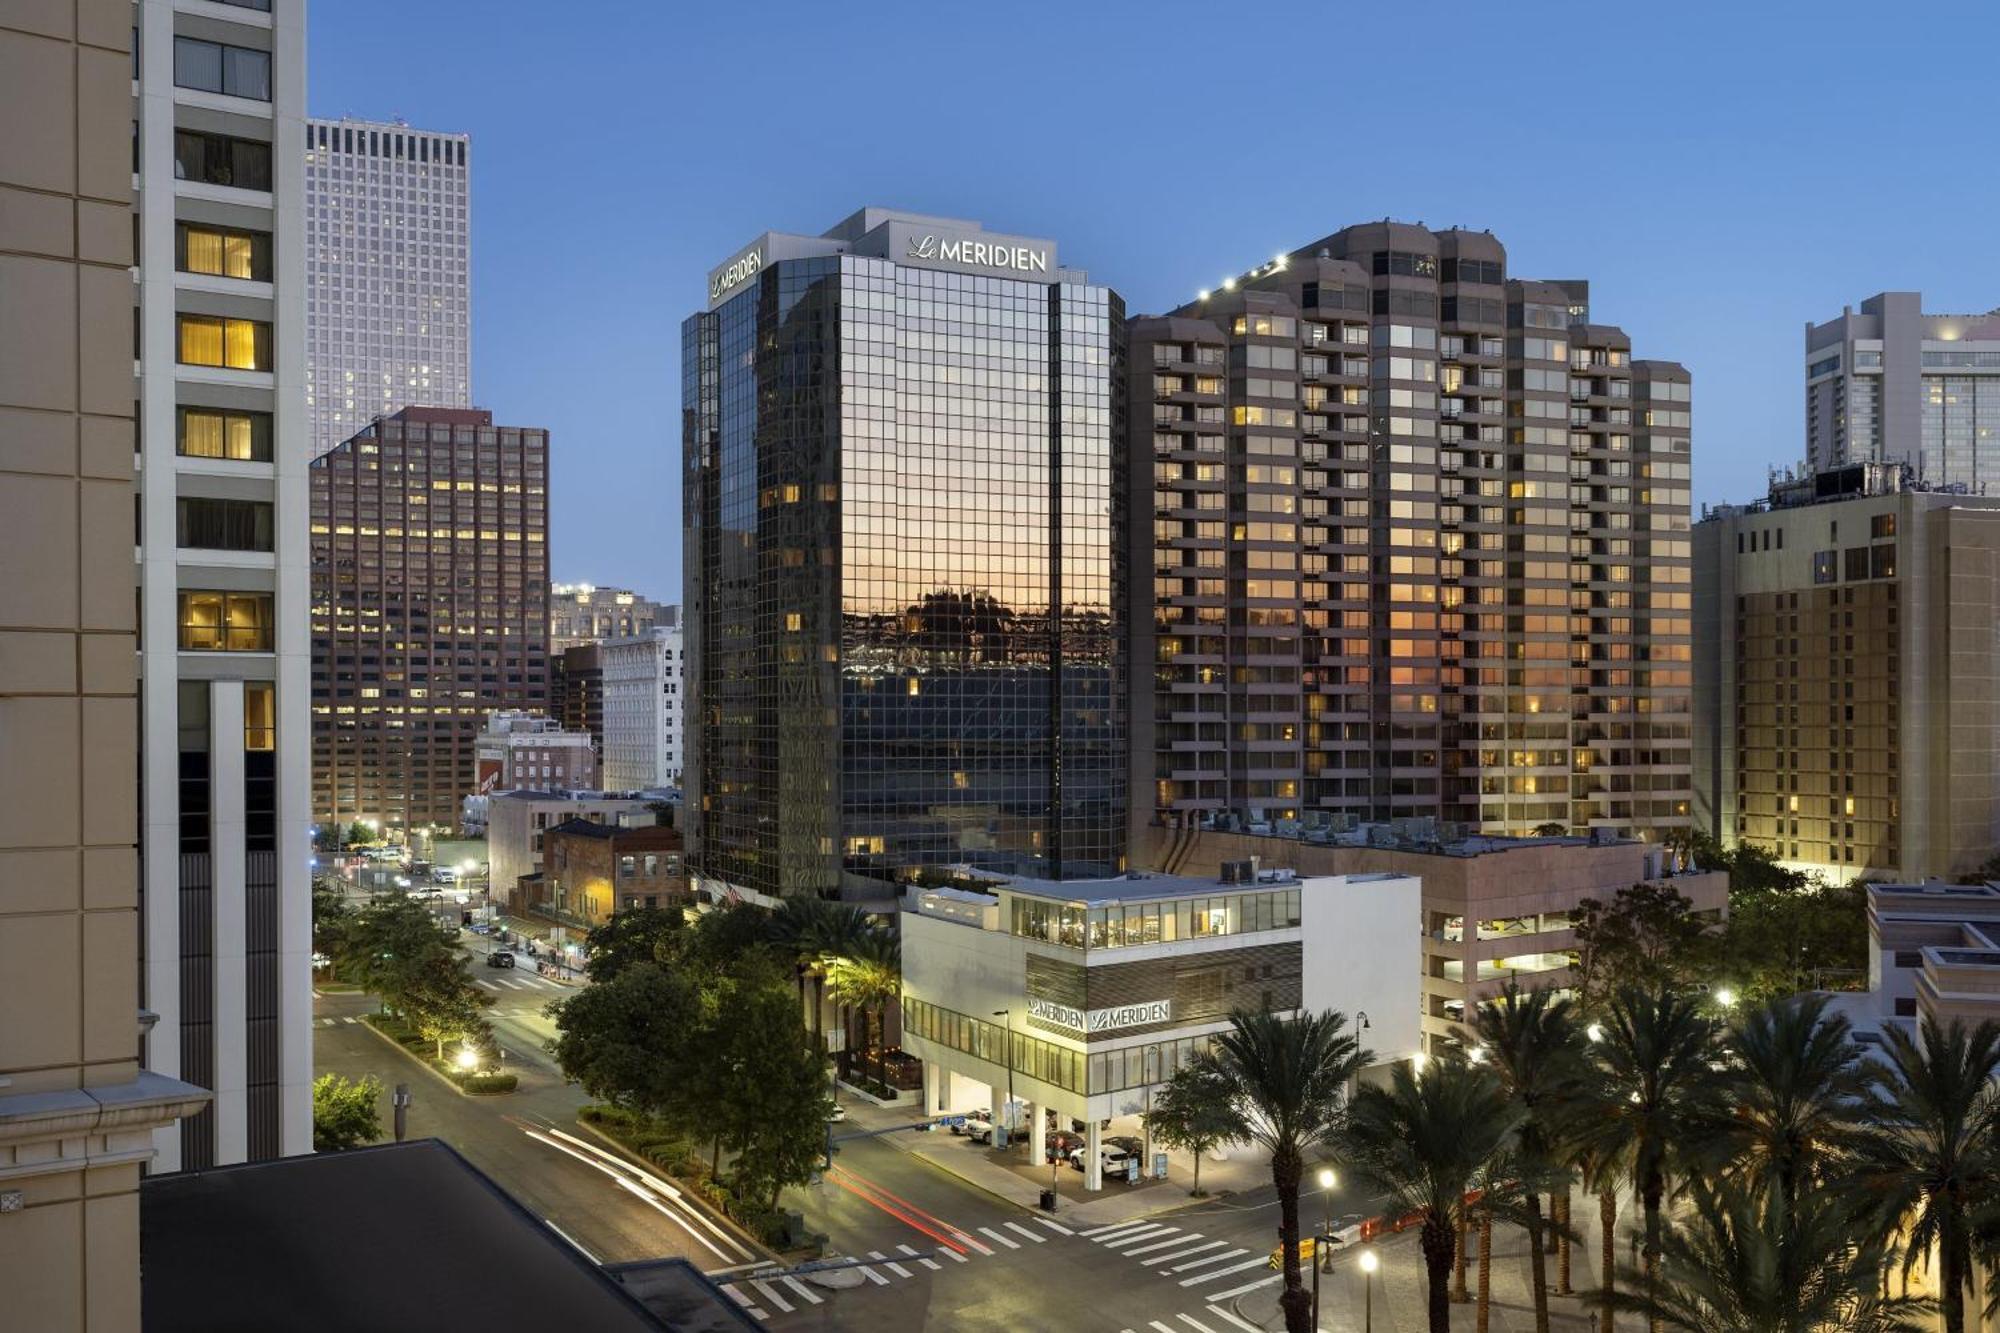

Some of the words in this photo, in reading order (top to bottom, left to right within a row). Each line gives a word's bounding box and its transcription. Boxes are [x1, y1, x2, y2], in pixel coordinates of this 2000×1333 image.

[908, 235, 937, 259] Le
[940, 239, 1046, 271] MERIDIEN
[721, 246, 761, 293] MERIDIEN
[1040, 1002, 1084, 1030] MERIDIEN
[1091, 1010, 1108, 1030] Le
[1108, 1003, 1169, 1027] MERIDIEN
